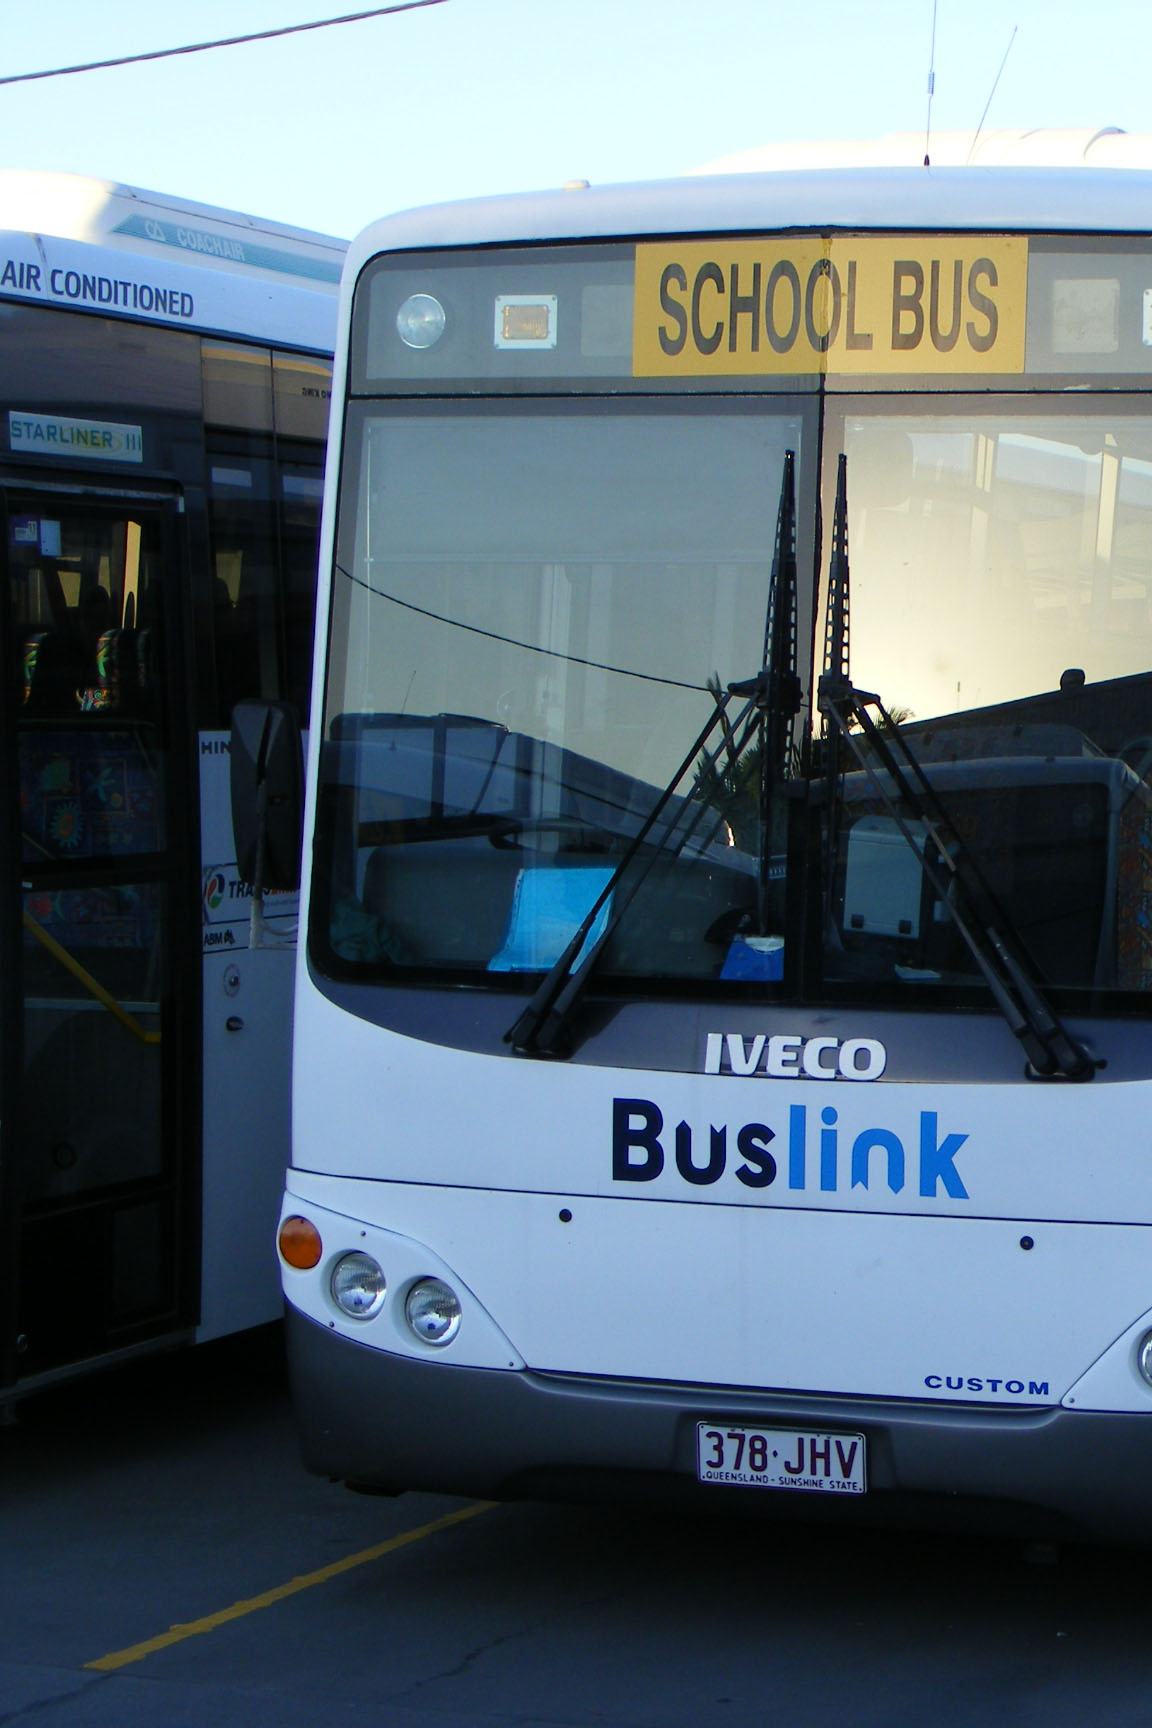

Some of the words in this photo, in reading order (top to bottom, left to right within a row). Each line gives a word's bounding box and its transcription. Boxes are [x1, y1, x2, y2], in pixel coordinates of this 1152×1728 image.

[1, 260, 41, 292] AIR
[51, 269, 195, 318] CONDITIONED
[657, 259, 873, 357] SCHOOL
[891, 257, 999, 354] BUS
[11, 420, 113, 448] STARLINER
[704, 1033, 887, 1081] IVECO
[612, 1097, 971, 1200] Buslink
[924, 1375, 1050, 1396] CUSTOM
[706, 1470, 769, 1484] QUEENSLAND
[778, 1476, 824, 1489] SUNSHINE
[829, 1481, 859, 1491] STATE
